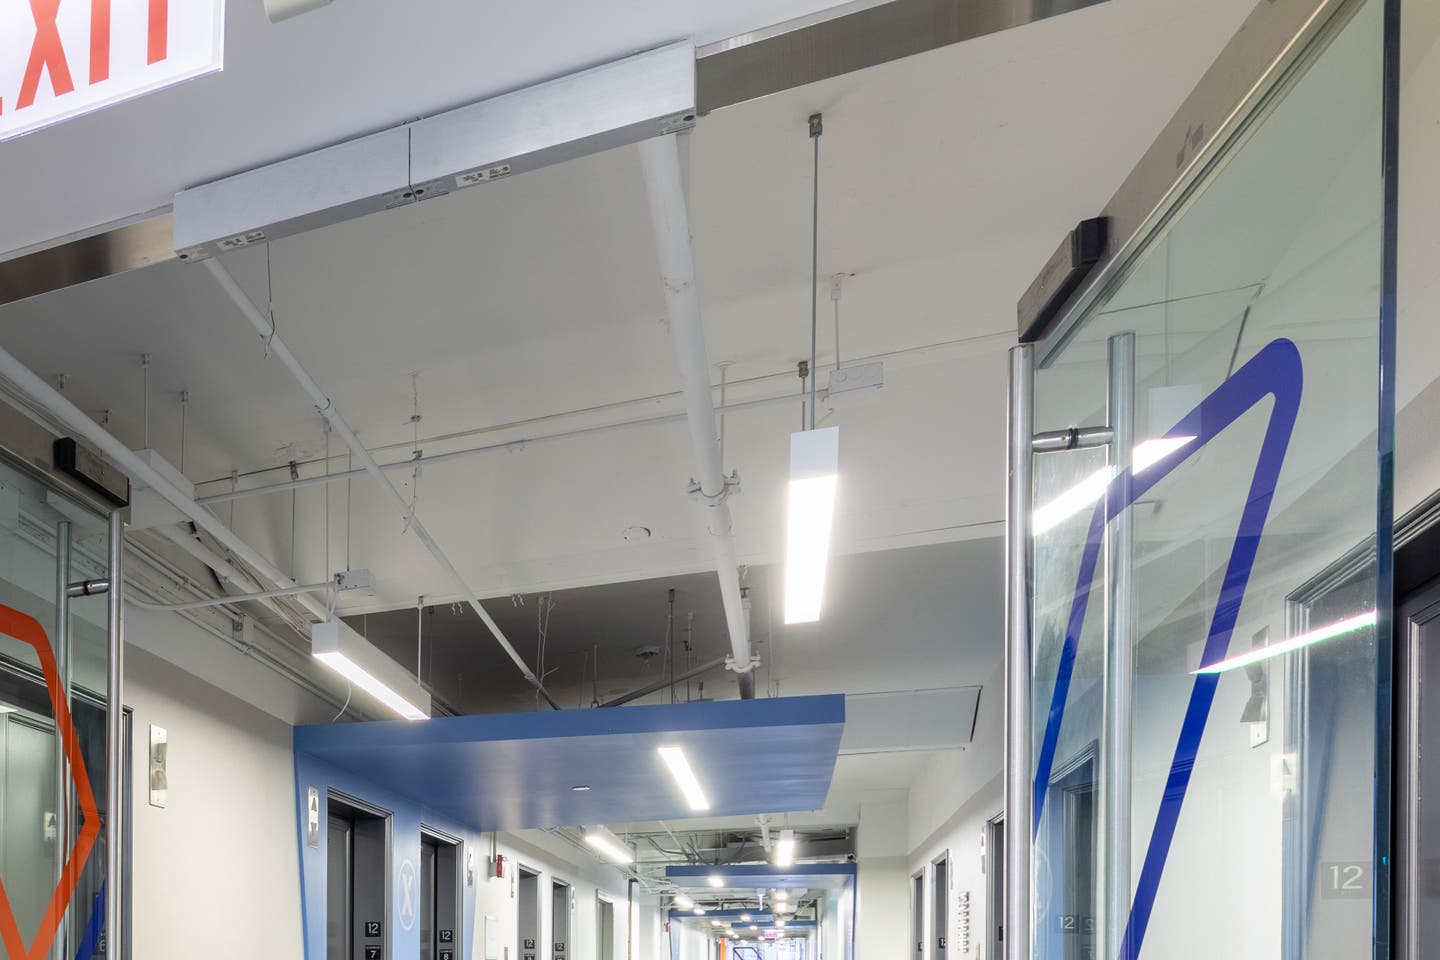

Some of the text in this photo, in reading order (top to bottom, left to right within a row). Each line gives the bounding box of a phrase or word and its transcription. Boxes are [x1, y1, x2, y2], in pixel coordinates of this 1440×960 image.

[1329, 864, 1364, 889] 12
[368, 923, 379, 934] 12
[1058, 916, 1074, 929] 12
[441, 931, 451, 940] 12
